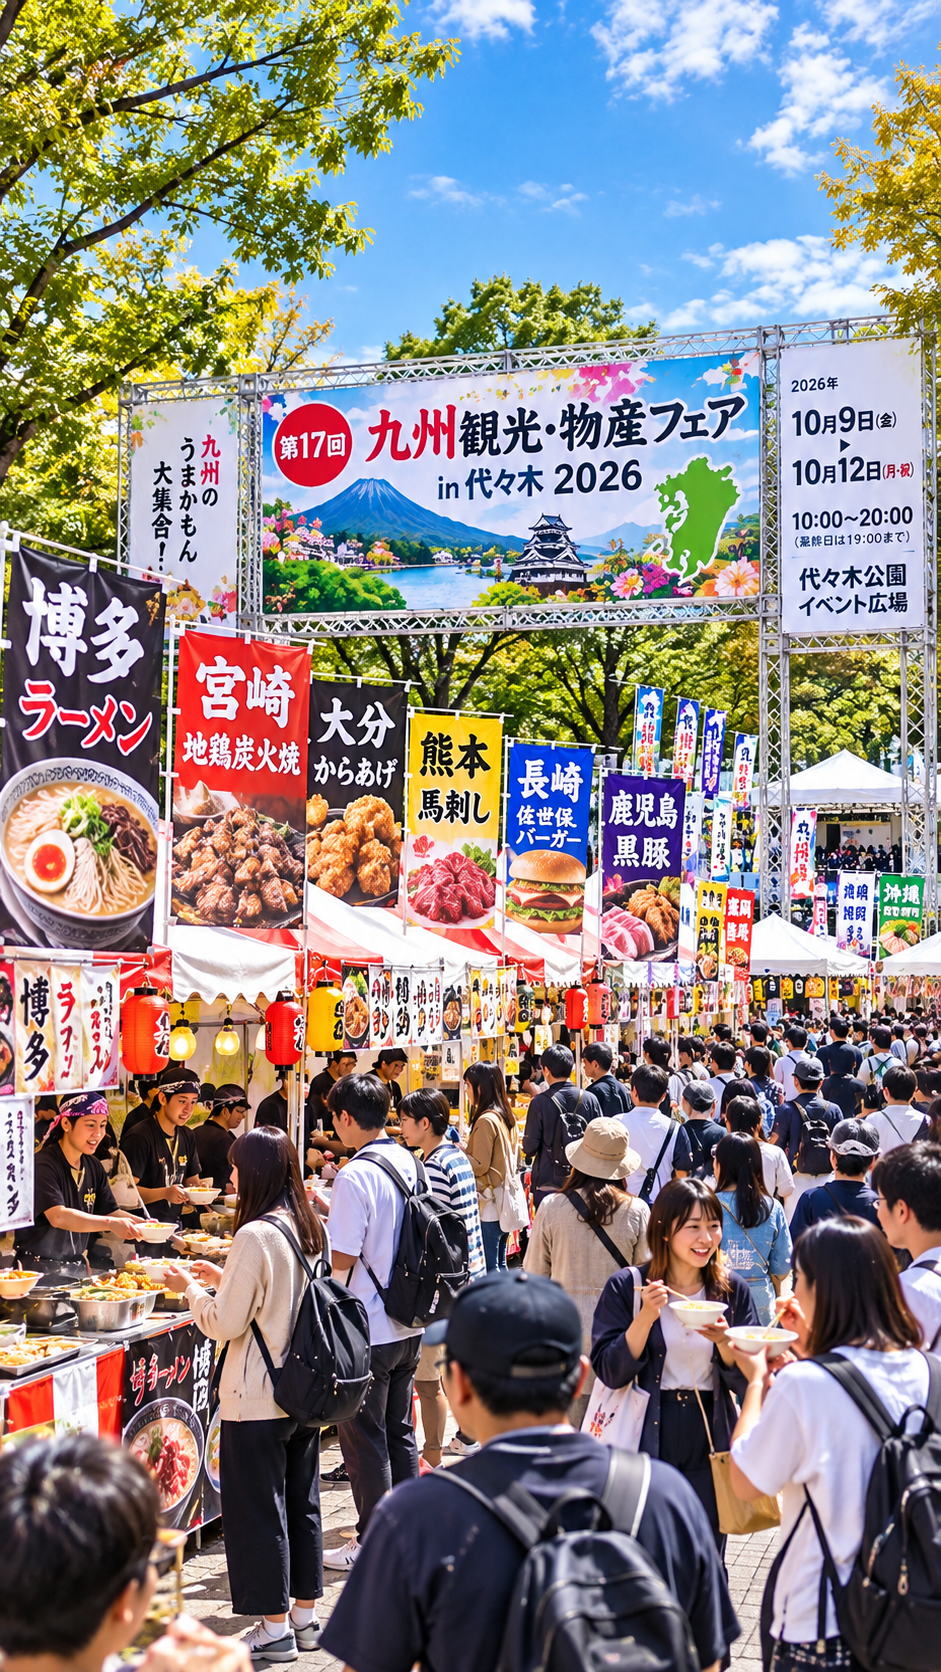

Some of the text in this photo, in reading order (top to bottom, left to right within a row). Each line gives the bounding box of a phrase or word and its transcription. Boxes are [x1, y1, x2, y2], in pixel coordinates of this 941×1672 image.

[791, 377, 839, 393] 2026年
[279, 431, 347, 461] 第17回
[365, 395, 746, 463] 九州観光・物産フェア
[200, 434, 221, 507] 九州の
[438, 459, 643, 501] in 代々木 2026
[179, 437, 198, 564] うまかもん
[799, 563, 907, 592] 代々木公園
[798, 592, 908, 617] イベント広場
[22, 576, 145, 684] 博多
[195, 655, 297, 730] 宮崎
[19, 678, 153, 757] ラーメン
[319, 696, 396, 750] 大分
[181, 731, 301, 777] 地鶏炭火焼
[313, 754, 399, 790] からあげ
[419, 731, 492, 779] 熊本
[516, 757, 584, 804] 長崎
[417, 787, 492, 826] 馬刺し
[515, 804, 578, 829] 佐世保
[609, 789, 679, 830] 鹿児島
[515, 825, 582, 850] バーガー
[612, 834, 672, 870] 黒豚
[20, 975, 50, 1082] 博多
